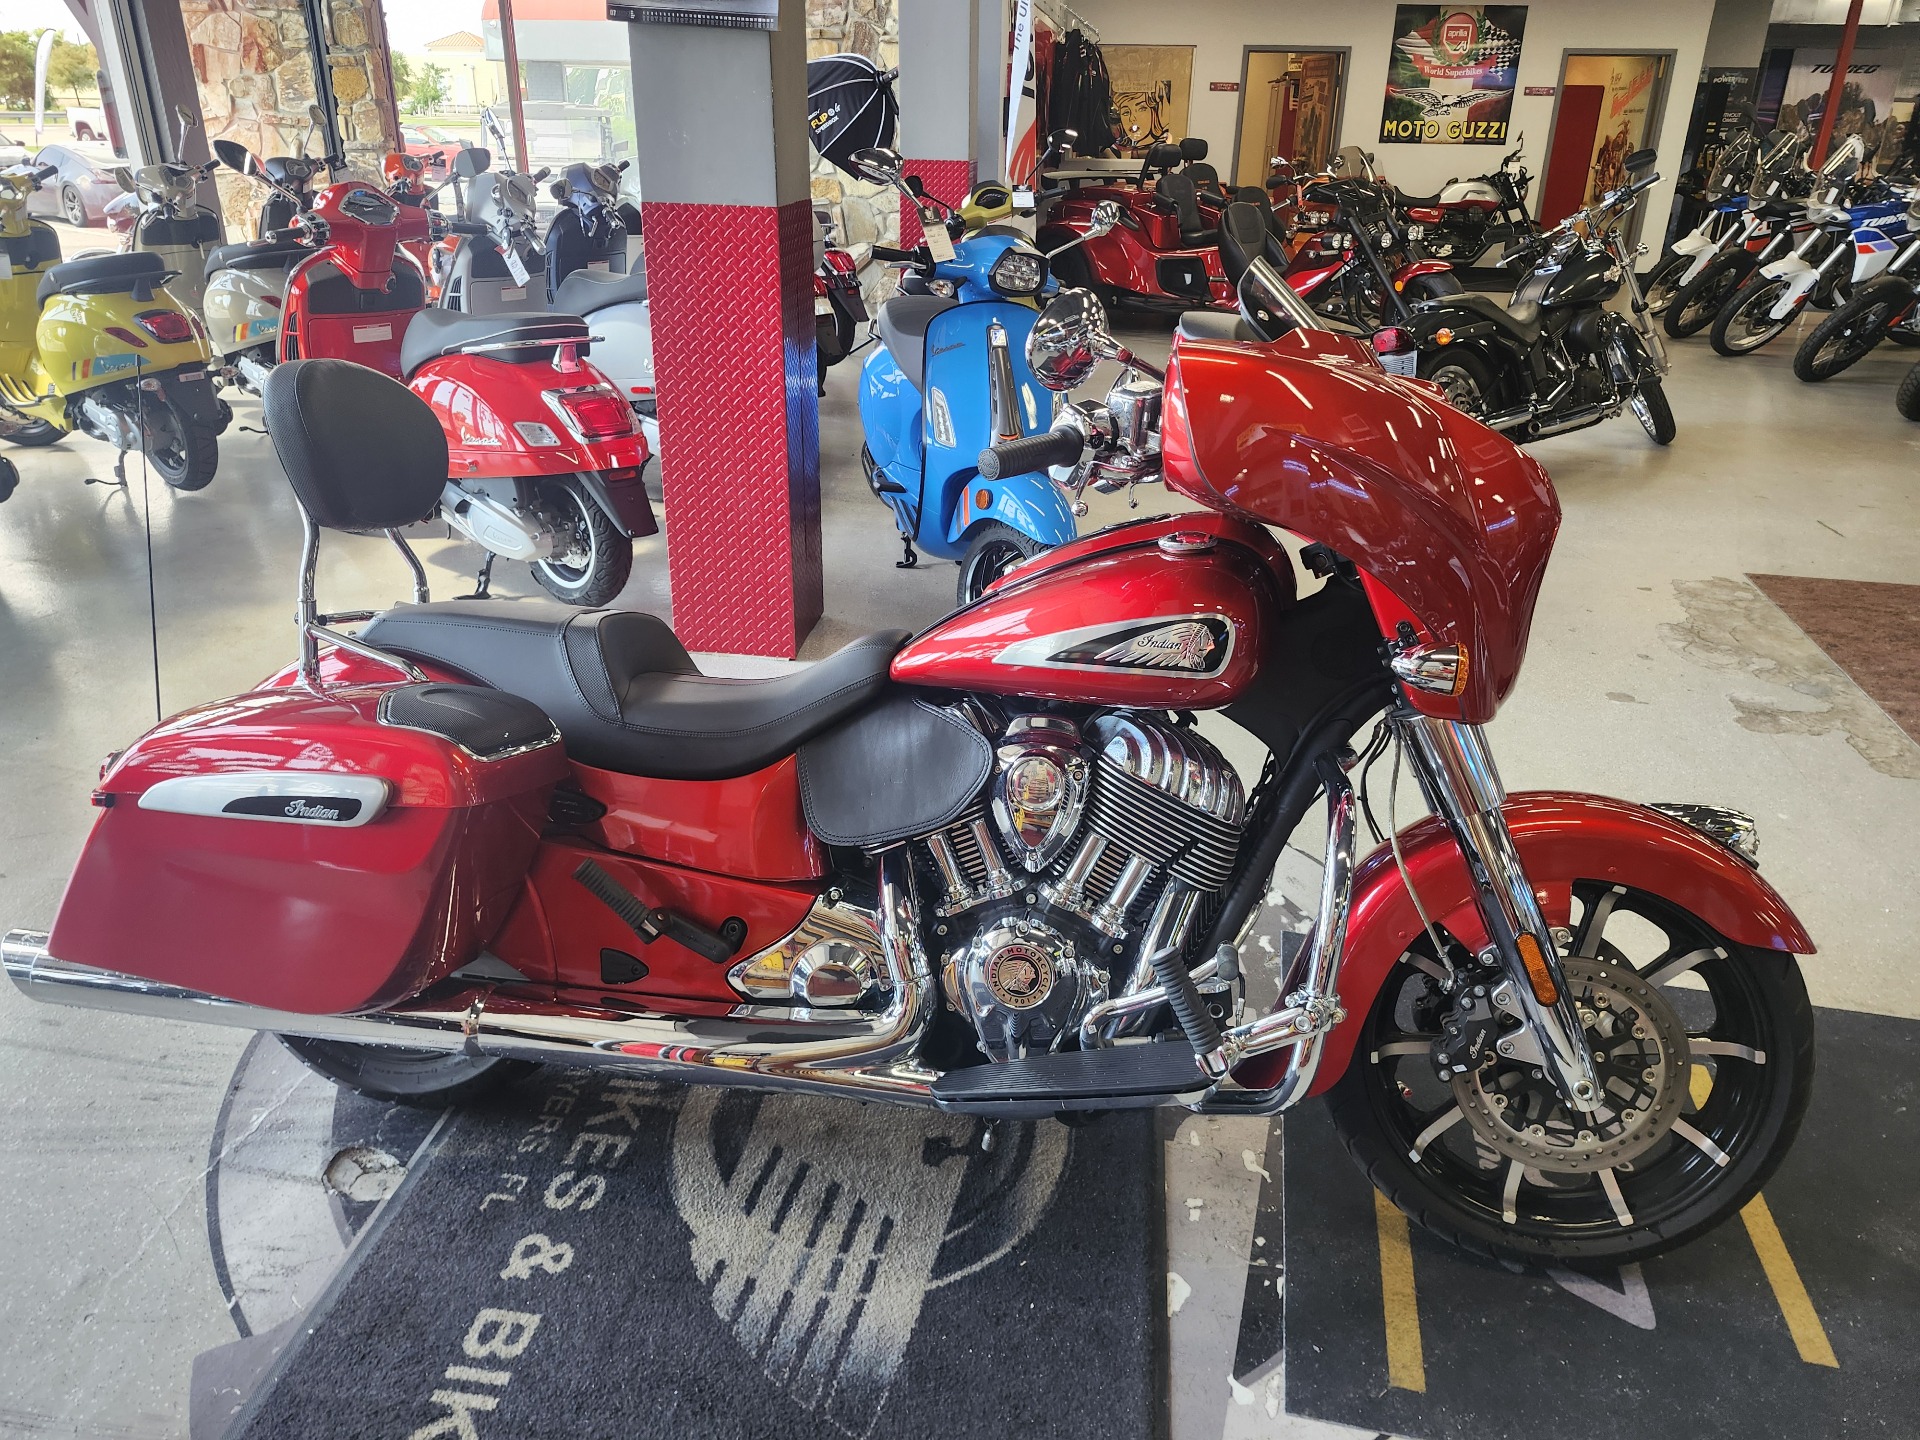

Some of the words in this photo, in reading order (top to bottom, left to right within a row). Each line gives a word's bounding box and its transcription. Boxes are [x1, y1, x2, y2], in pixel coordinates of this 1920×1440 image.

[1447, 29, 1468, 38] aprilia
[1424, 65, 1445, 76] World
[1446, 67, 1483, 78] Superbikes
[1383, 119, 1440, 139] MOTO
[1446, 121, 1508, 140] GUZZI
[460, 425, 502, 446] Vespa
[1137, 634, 1184, 651] Indian
[284, 799, 340, 820] Indian
[991, 953, 1005, 992] INDIAN
[1007, 947, 1049, 996] MOTORCYCLE
[1469, 1028, 1487, 1059] Indian
[499, 1232, 575, 1281] &
